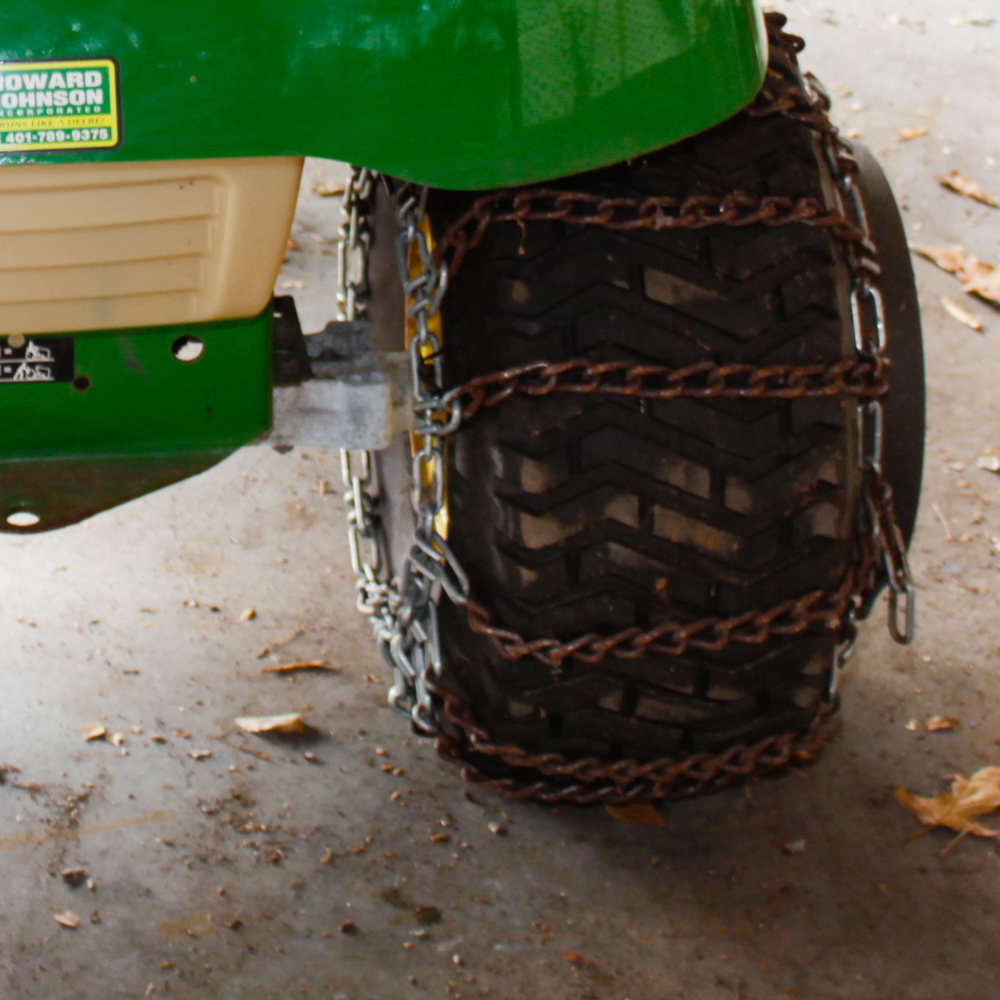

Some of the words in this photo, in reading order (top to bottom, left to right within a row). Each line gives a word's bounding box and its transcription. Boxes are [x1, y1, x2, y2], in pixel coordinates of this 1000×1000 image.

[0, 120, 28, 129] RUNS
[31, 119, 53, 128] LIKE
[5, 128, 109, 144] 401-789-9375
